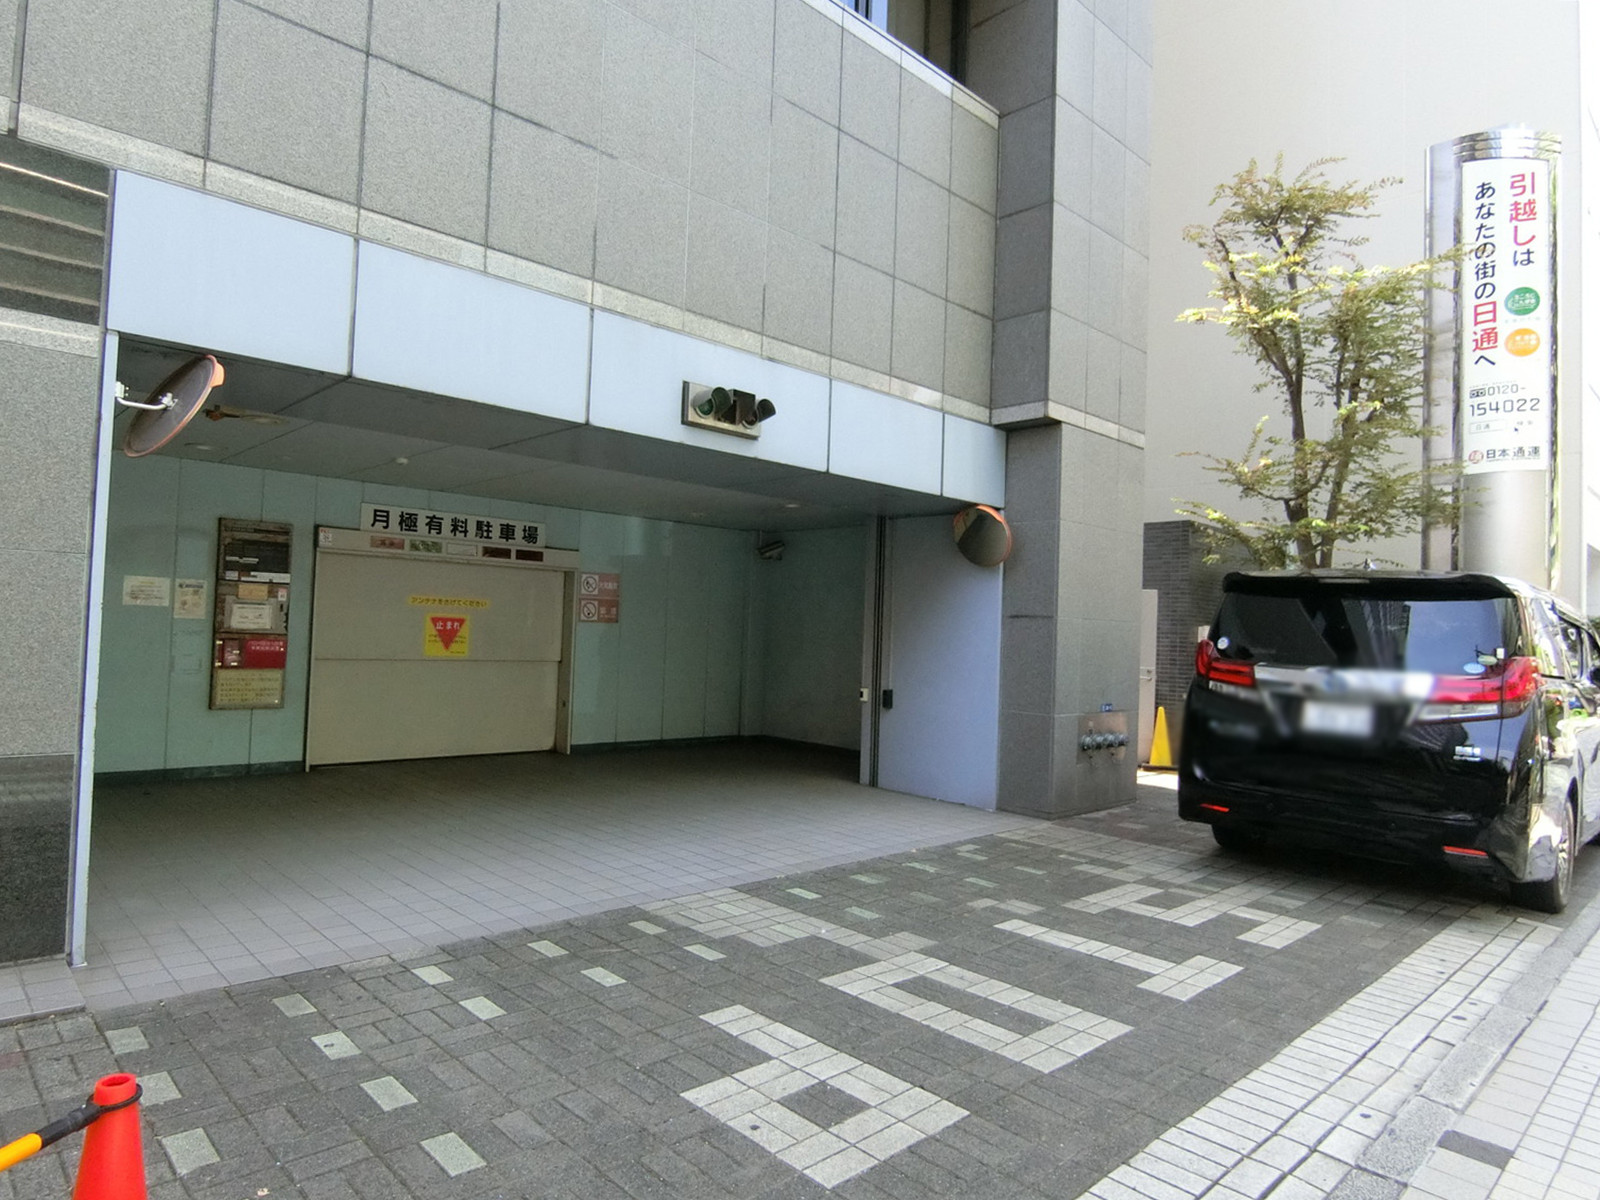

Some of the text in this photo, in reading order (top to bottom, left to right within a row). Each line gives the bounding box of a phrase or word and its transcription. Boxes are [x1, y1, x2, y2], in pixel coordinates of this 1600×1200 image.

[1509, 171, 1538, 267] 引越しは
[1472, 181, 1498, 366] あなたの街の日通へ
[1469, 398, 1541, 417] 154022
[1486, 445, 1541, 459] 日本通運
[371, 508, 540, 545] 月極有料駐車場
[435, 620, 460, 631] 止まれ
